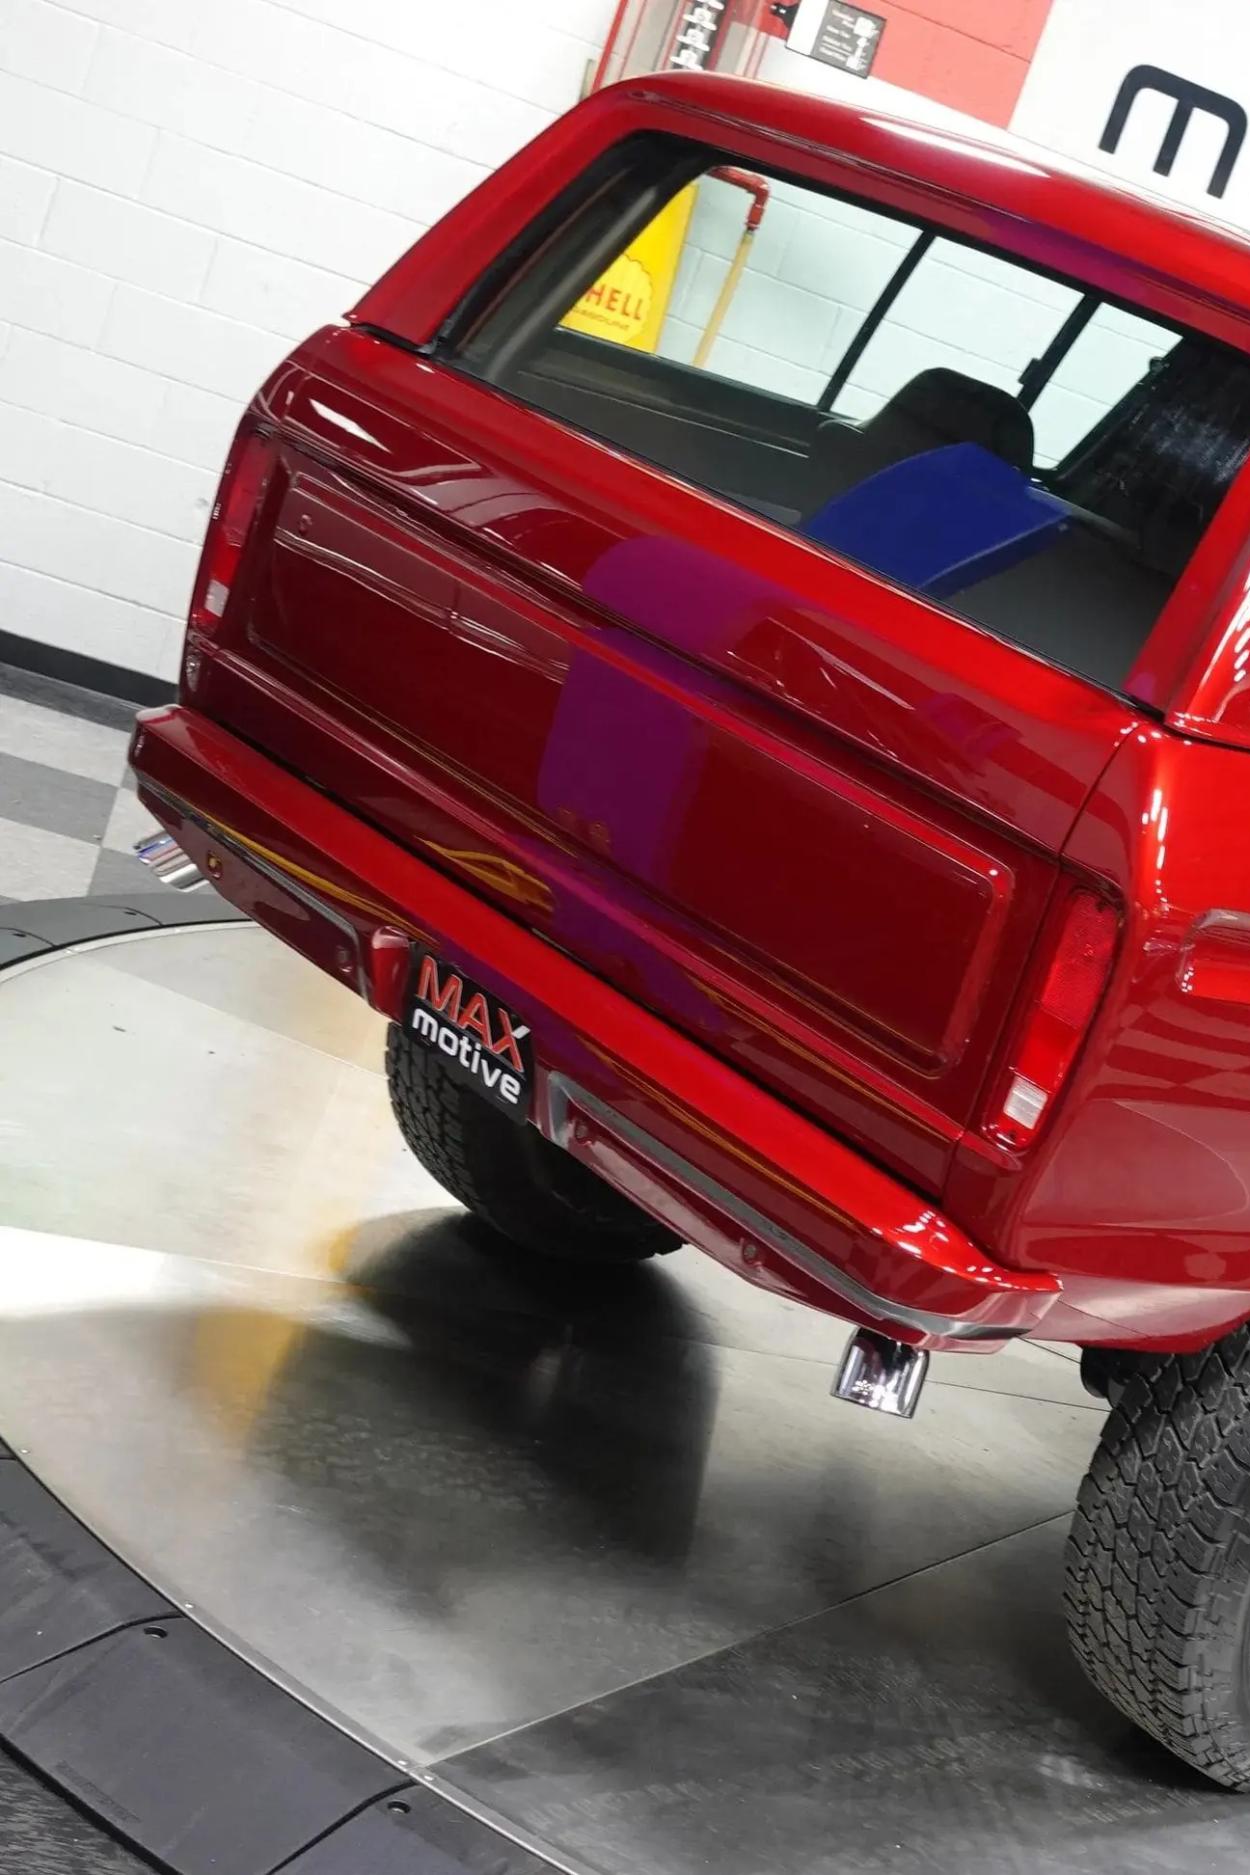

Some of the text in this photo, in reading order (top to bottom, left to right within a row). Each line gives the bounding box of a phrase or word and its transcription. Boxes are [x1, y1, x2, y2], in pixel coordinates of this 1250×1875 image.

[584, 283, 643, 321] HELL
[411, 1007, 522, 1105] motive
[416, 954, 531, 1074] MAX
